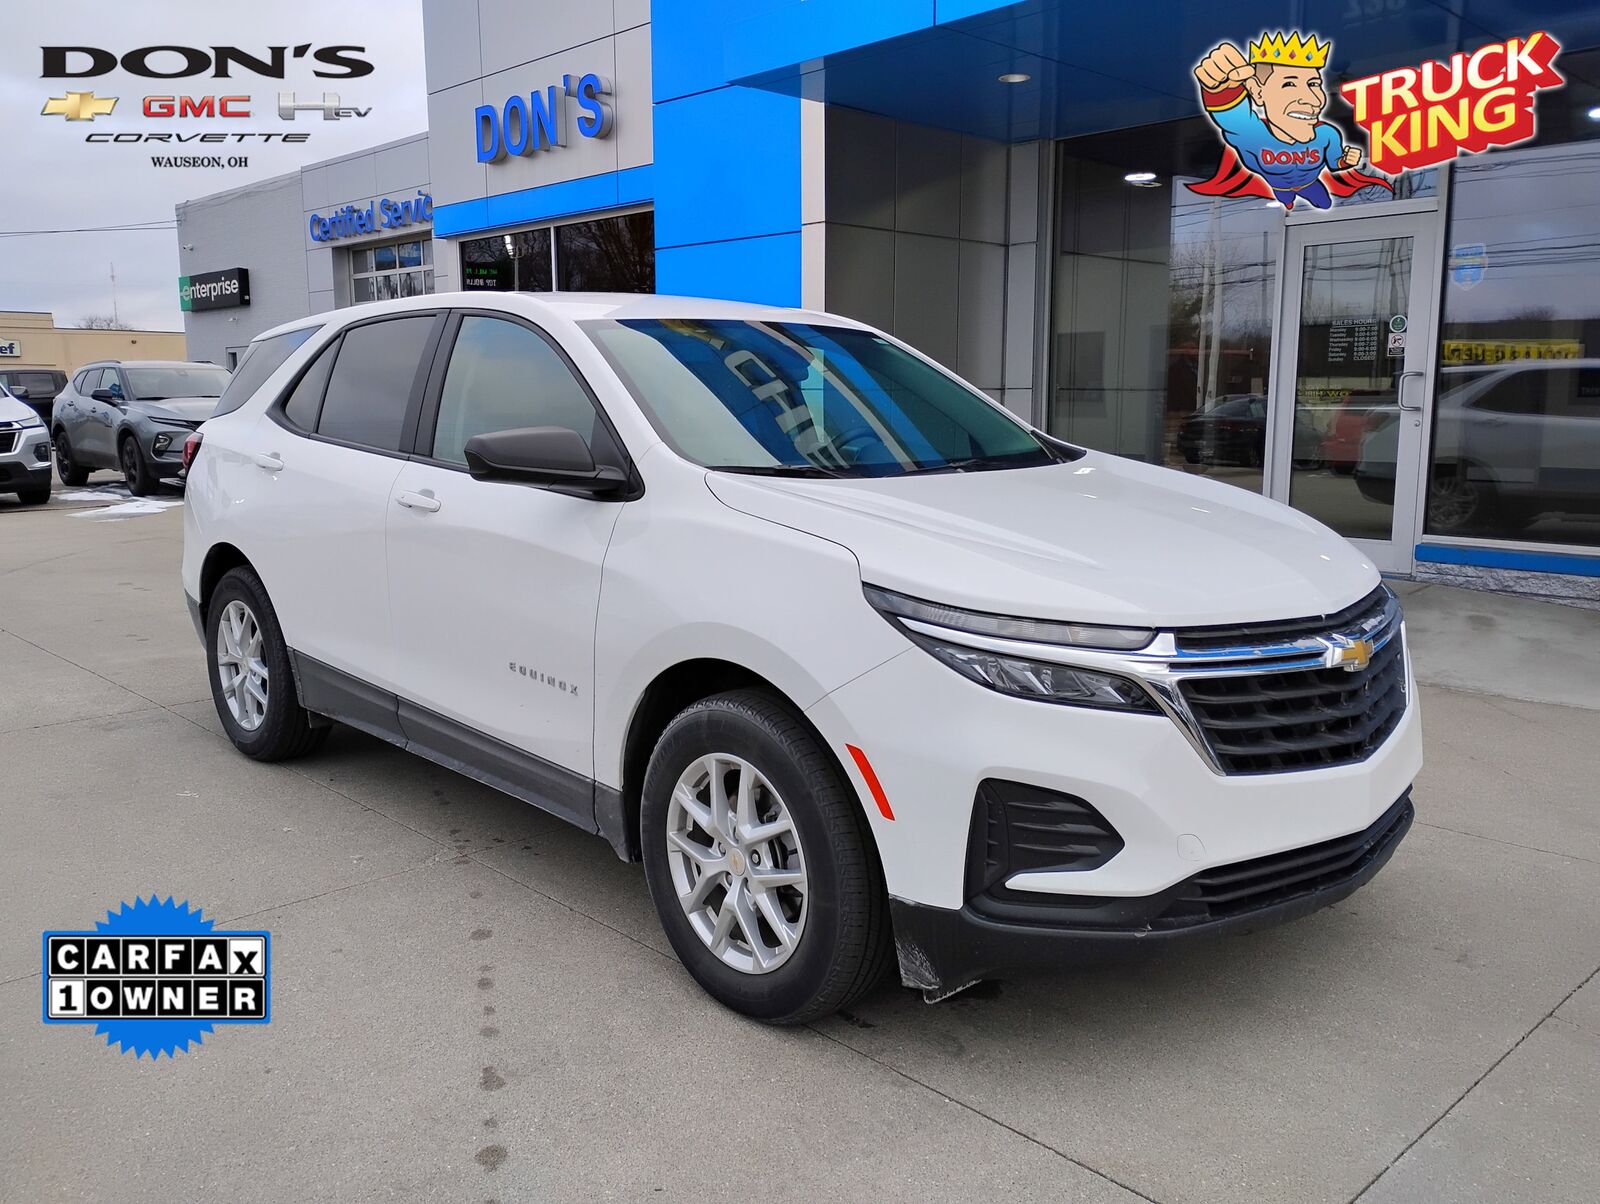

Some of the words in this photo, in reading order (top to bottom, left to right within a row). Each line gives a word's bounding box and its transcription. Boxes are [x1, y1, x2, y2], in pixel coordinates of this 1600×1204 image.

[474, 72, 606, 164] DON'S
[309, 200, 375, 241] Certified
[181, 276, 239, 302] enterprise
[509, 662, 579, 696] EQUINOX
